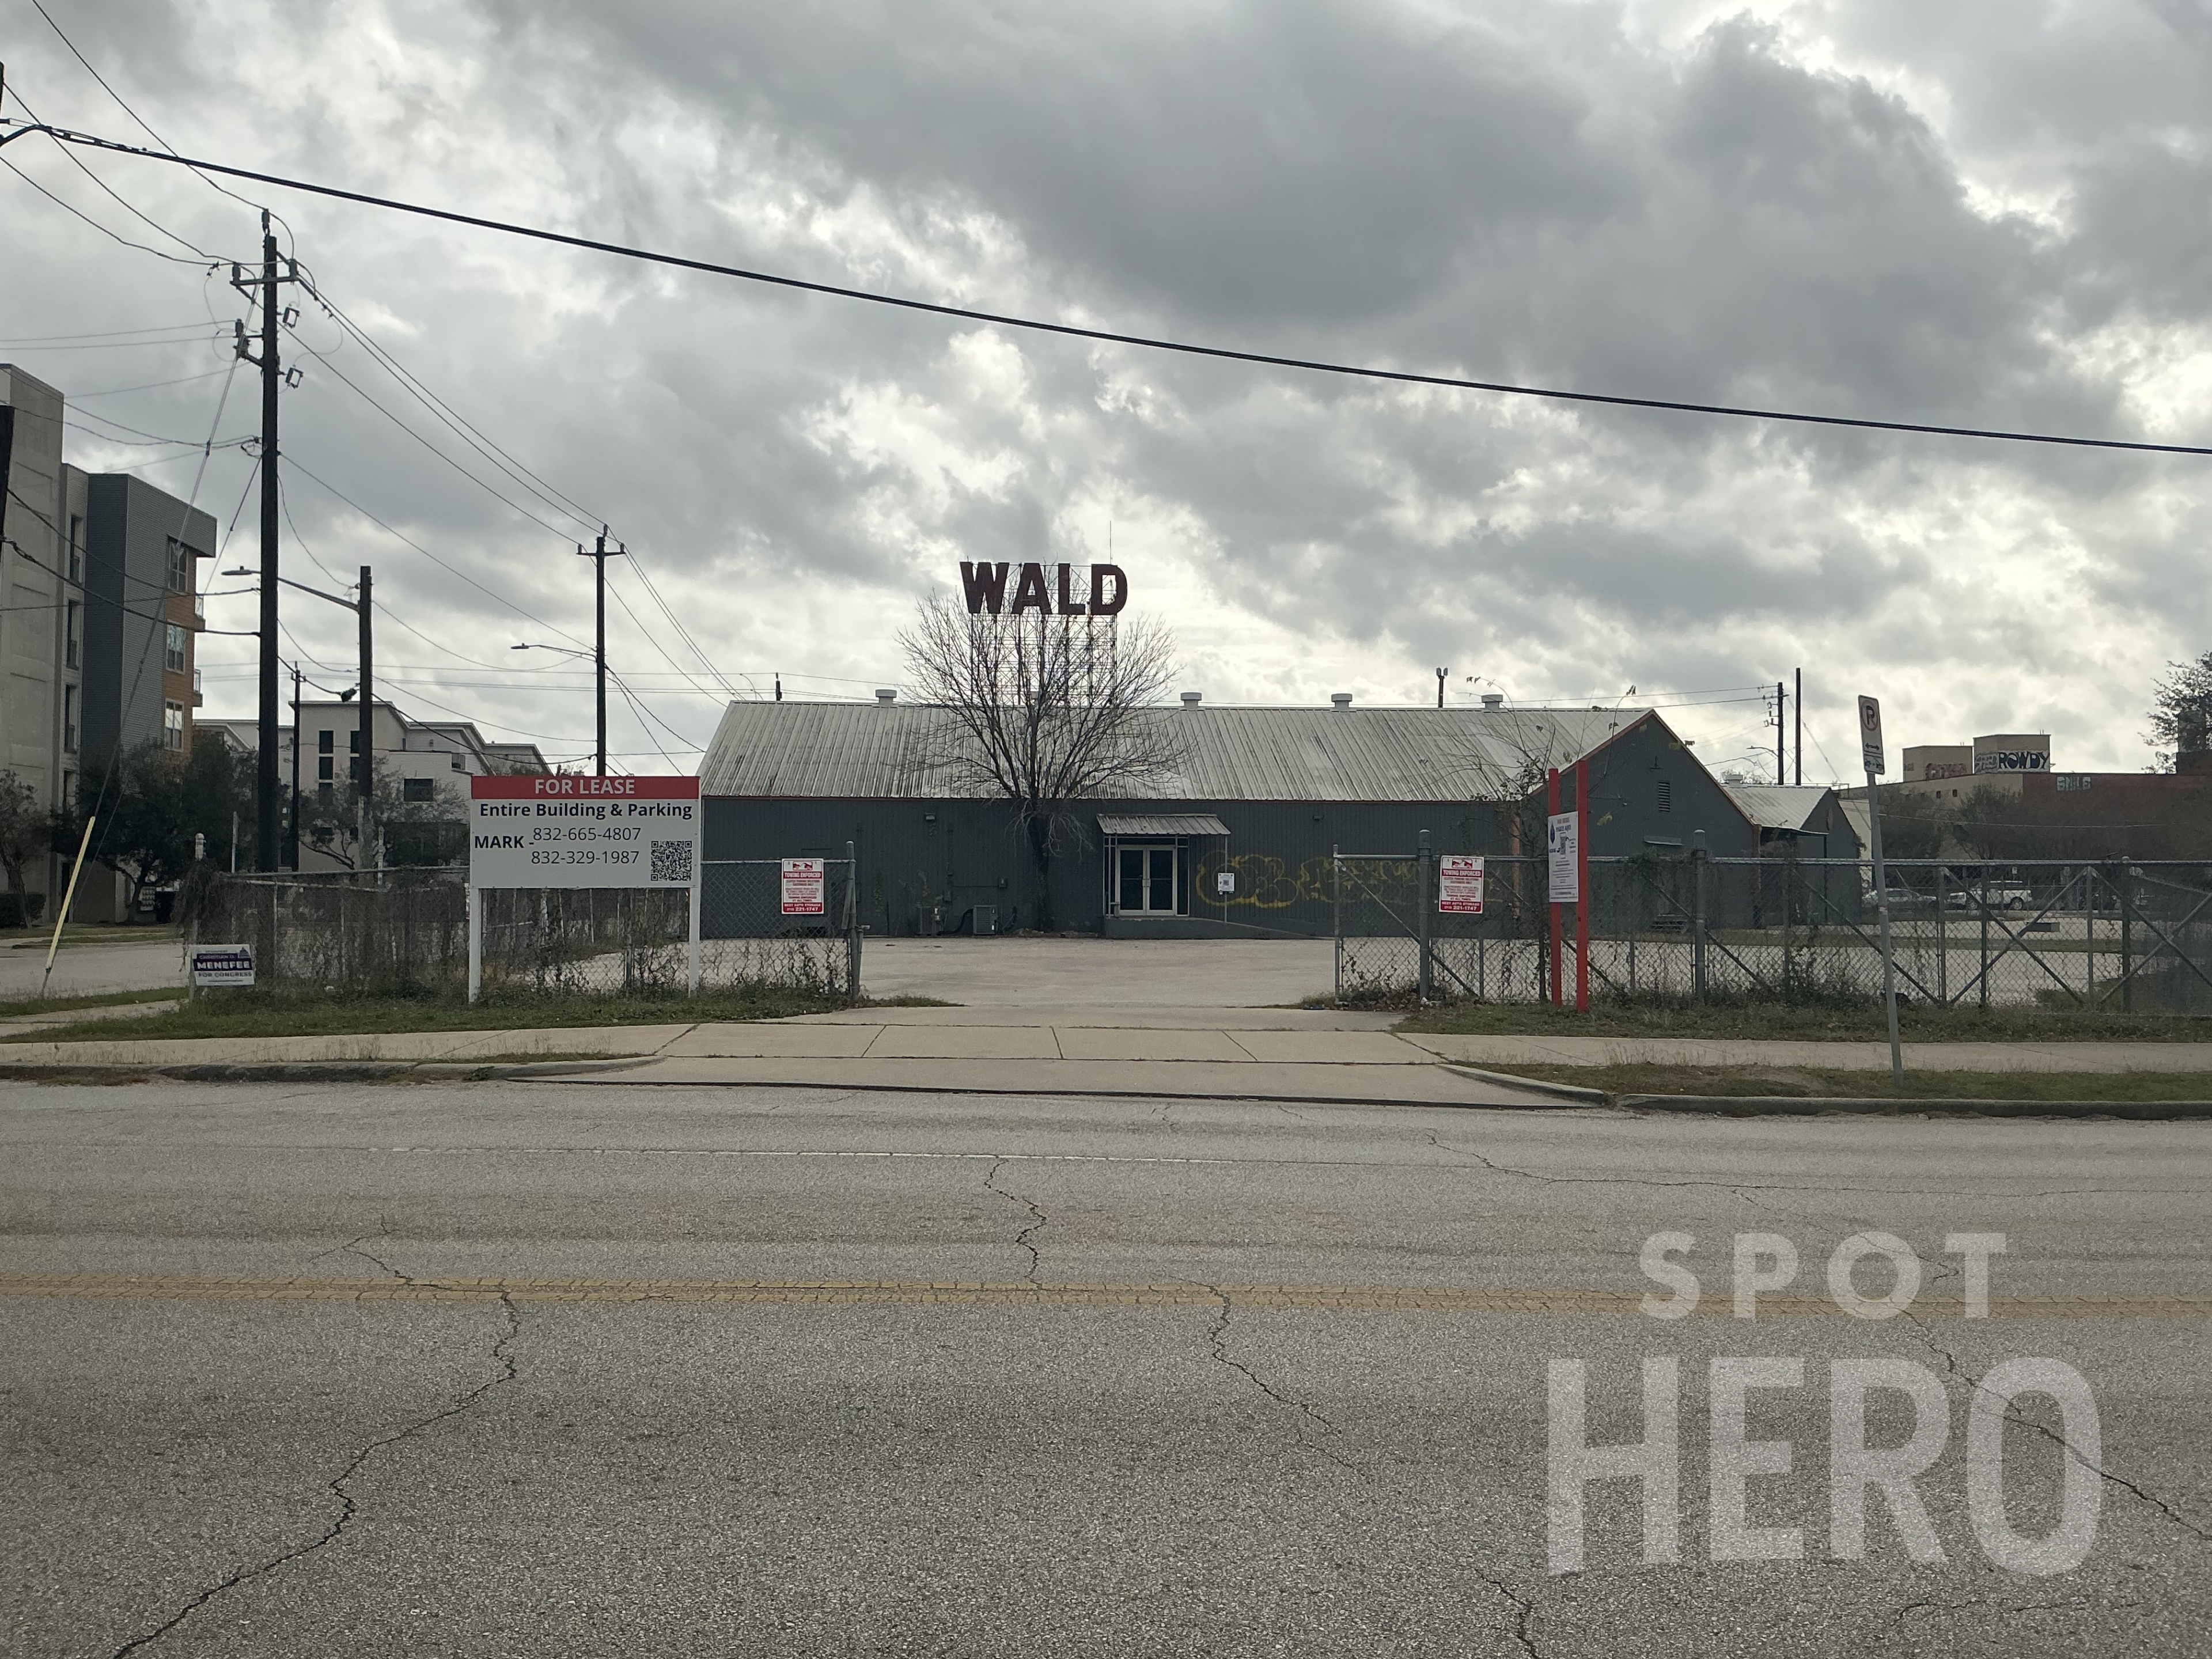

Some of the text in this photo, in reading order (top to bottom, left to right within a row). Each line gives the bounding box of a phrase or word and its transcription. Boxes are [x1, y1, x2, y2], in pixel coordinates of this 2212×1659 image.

[960, 562, 1127, 615] WALD
[1998, 751, 2050, 770] ROWDY
[535, 779, 635, 794] FOR LEASE
[480, 803, 692, 820] Entire Building & Parking
[533, 827, 641, 841] 832-665-4807
[474, 835, 525, 849] MARK
[531, 850, 639, 864] 832-329-1987
[196, 961, 250, 969] MENEFEE
